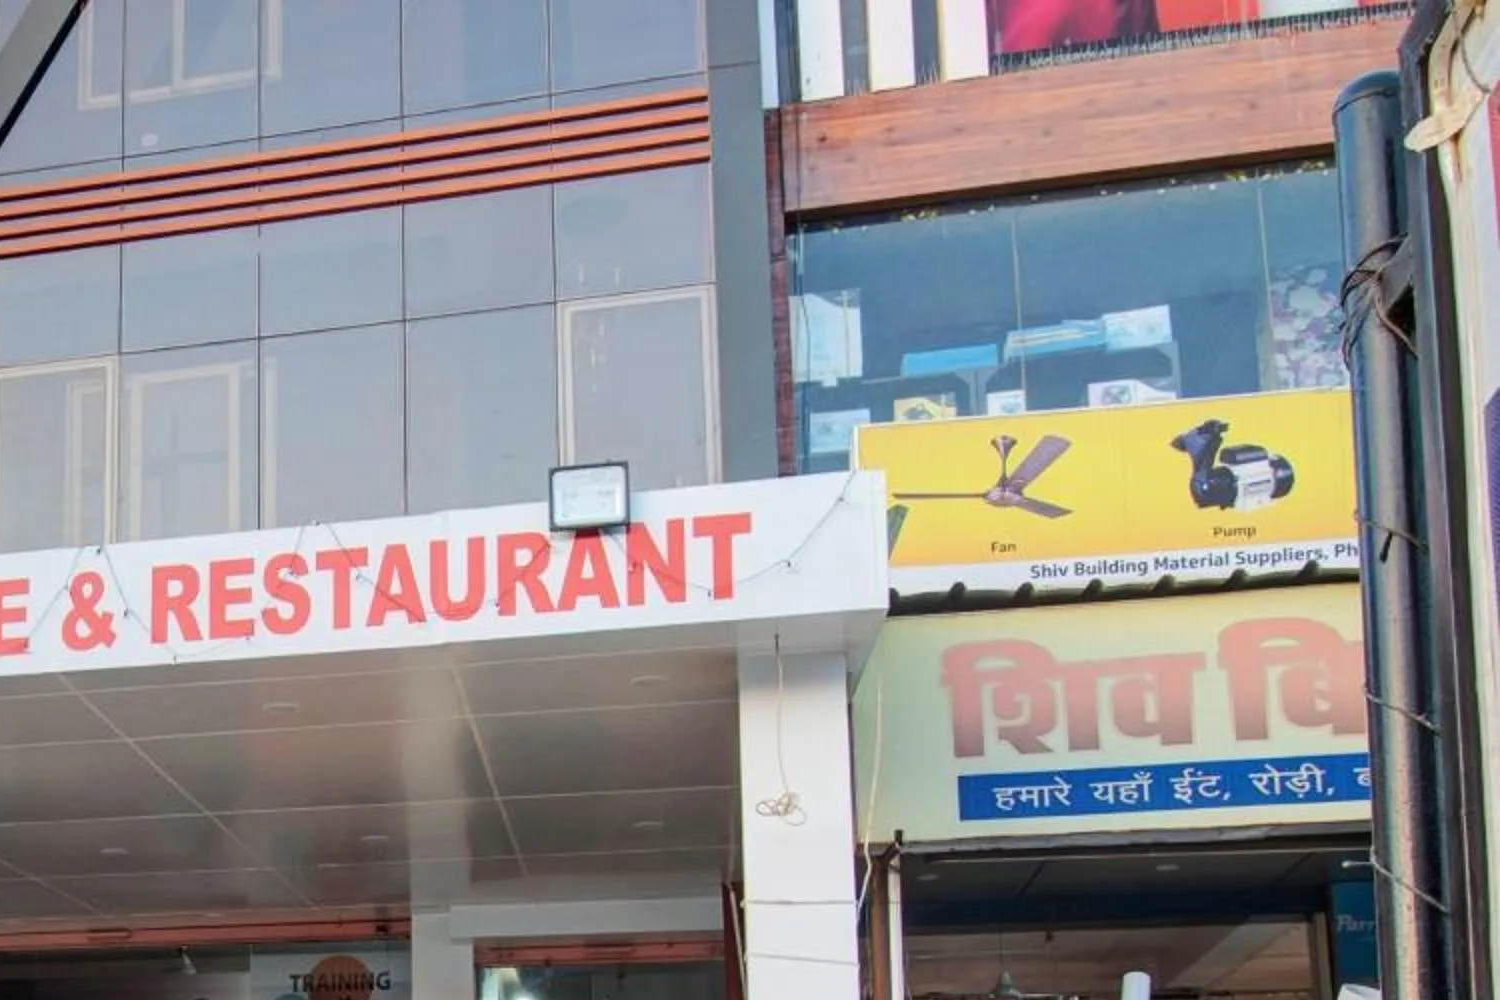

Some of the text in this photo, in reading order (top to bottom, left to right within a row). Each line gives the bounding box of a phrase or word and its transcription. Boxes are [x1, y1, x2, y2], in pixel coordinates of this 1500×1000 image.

[1212, 525, 1257, 540] Pump
[990, 541, 1017, 554] Fan
[1030, 563, 1068, 580] Shiv
[1074, 560, 1148, 578] Building
[1153, 553, 1229, 571] Material
[62, 571, 116, 652] &
[150, 512, 752, 644] RESTAURANT
[940, 638, 1205, 758] शिव
[993, 777, 1072, 810] हमारे
[1090, 770, 1154, 805] यहाँ
[290, 971, 391, 993] TRAINING
